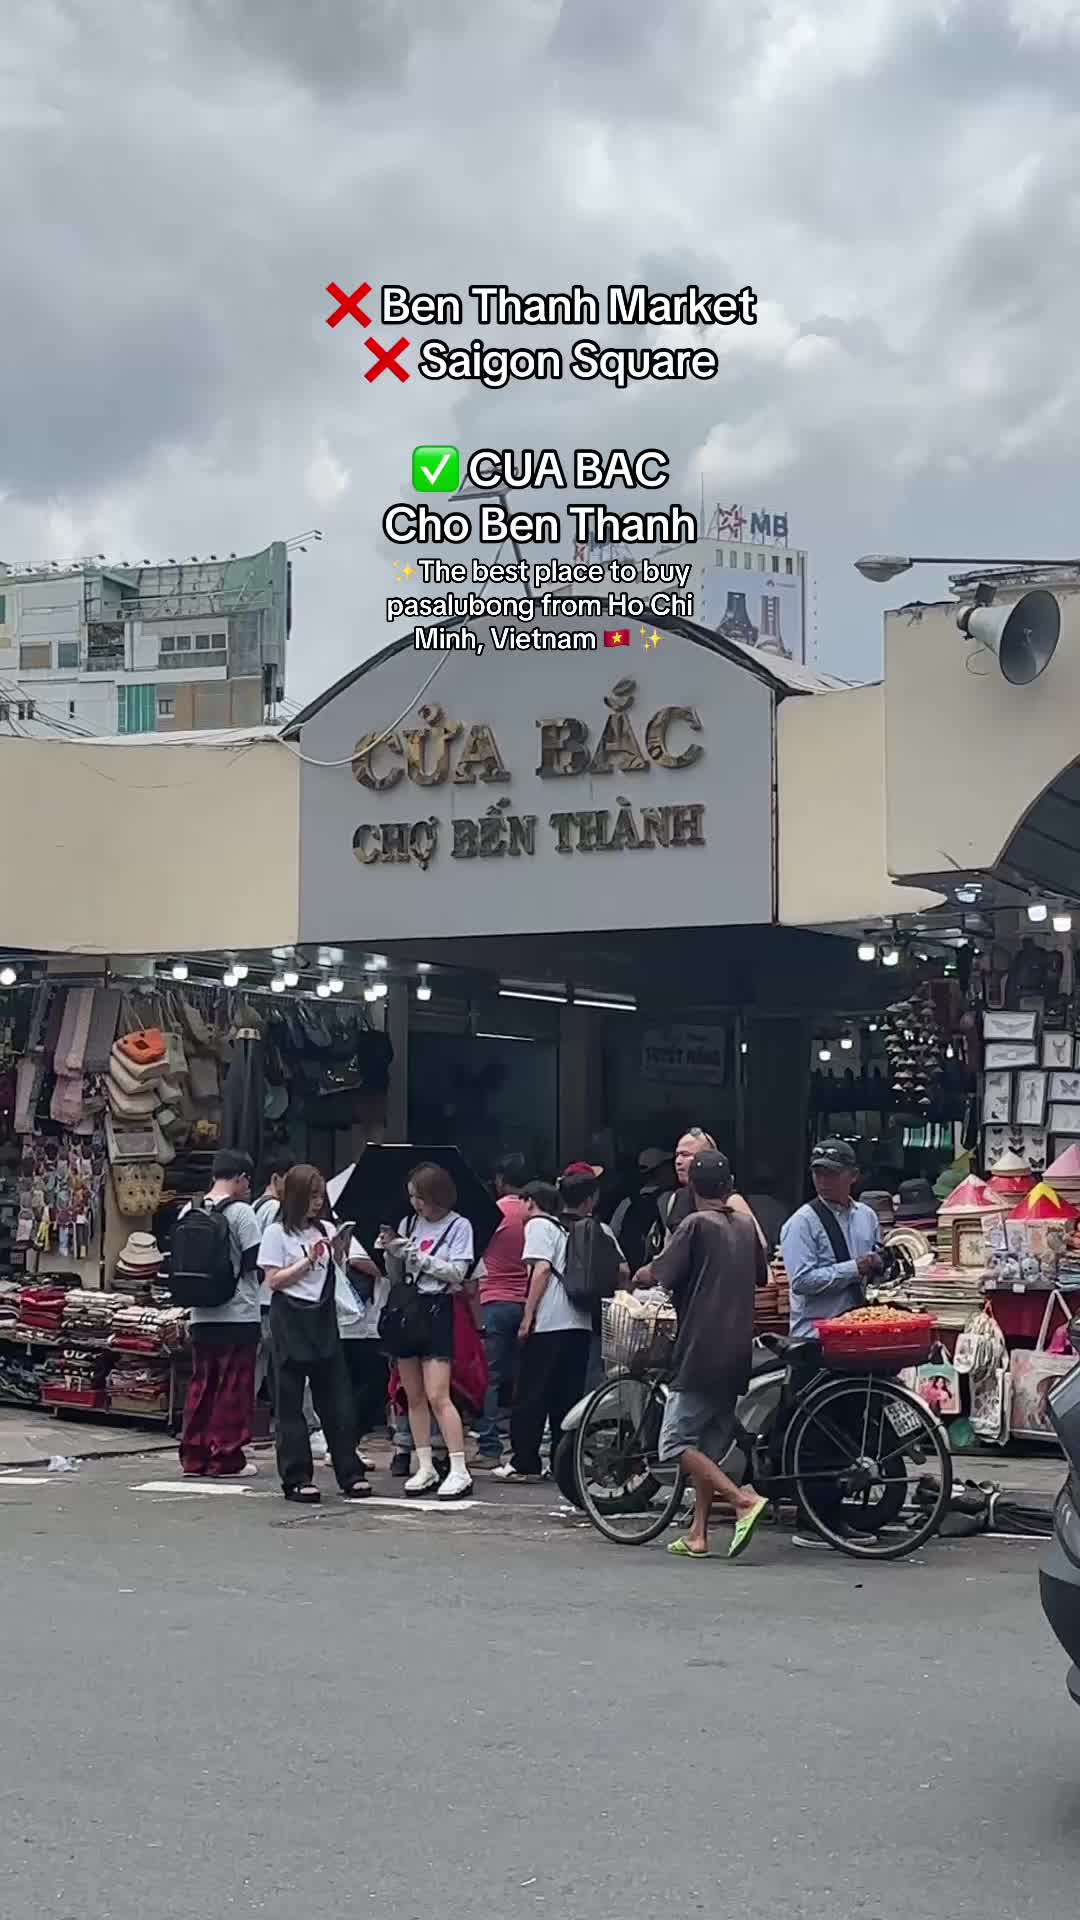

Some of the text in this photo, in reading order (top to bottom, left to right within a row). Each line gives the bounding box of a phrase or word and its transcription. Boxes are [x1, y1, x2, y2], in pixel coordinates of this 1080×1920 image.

[751, 511, 788, 537] MB
[352, 678, 703, 791] CỬA BẮC
[353, 796, 705, 871] CHỢ BẾN THÀNH
